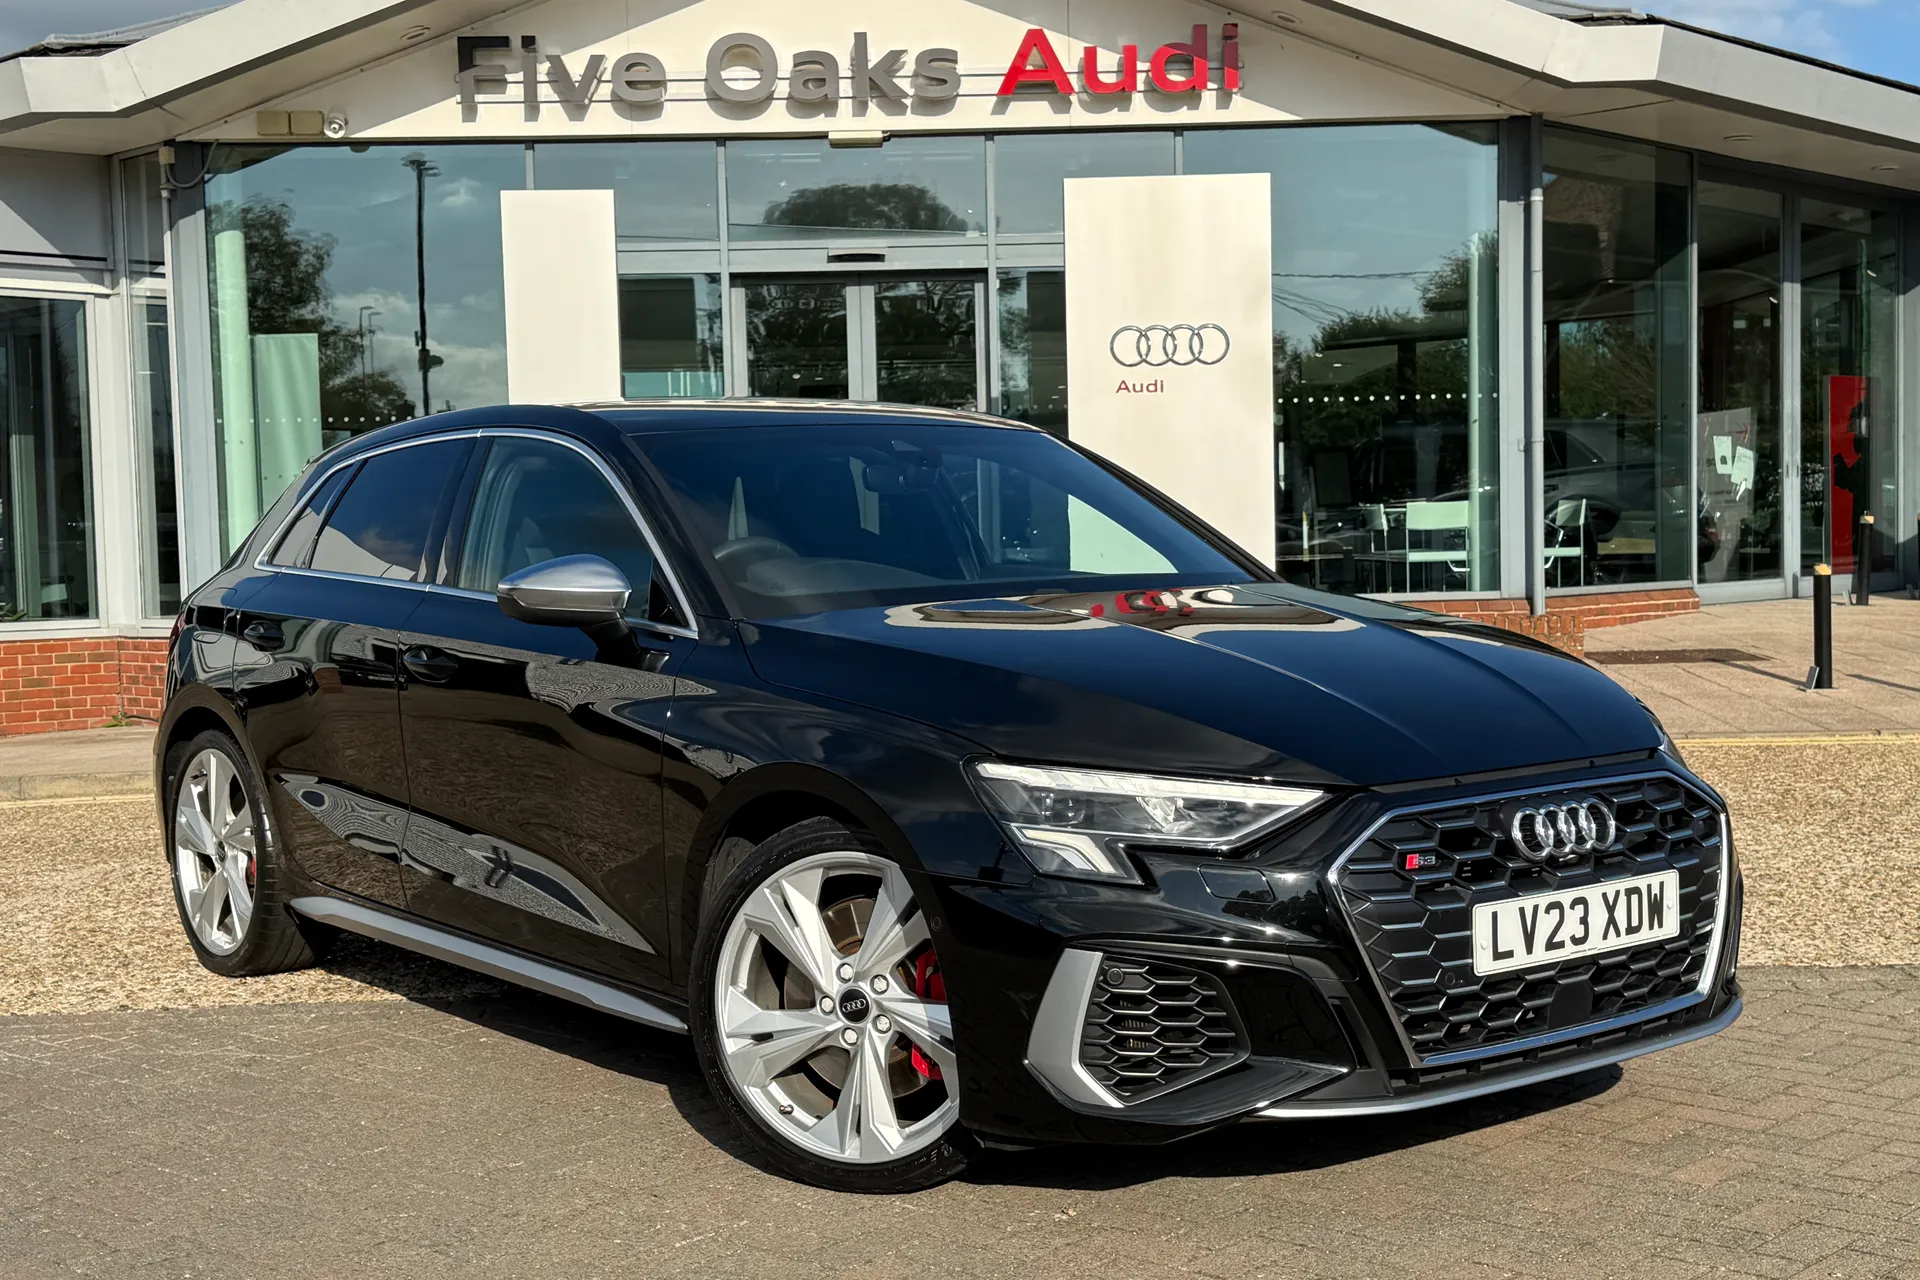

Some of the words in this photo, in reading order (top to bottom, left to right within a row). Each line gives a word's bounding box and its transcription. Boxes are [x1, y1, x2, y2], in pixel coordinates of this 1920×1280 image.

[457, 36, 667, 103] Five
[706, 32, 962, 101] Oaks
[997, 23, 1240, 96] Audi
[1115, 379, 1164, 393] Audi
[1491, 896, 1590, 962] LV23
[1601, 880, 1665, 941] XDW
